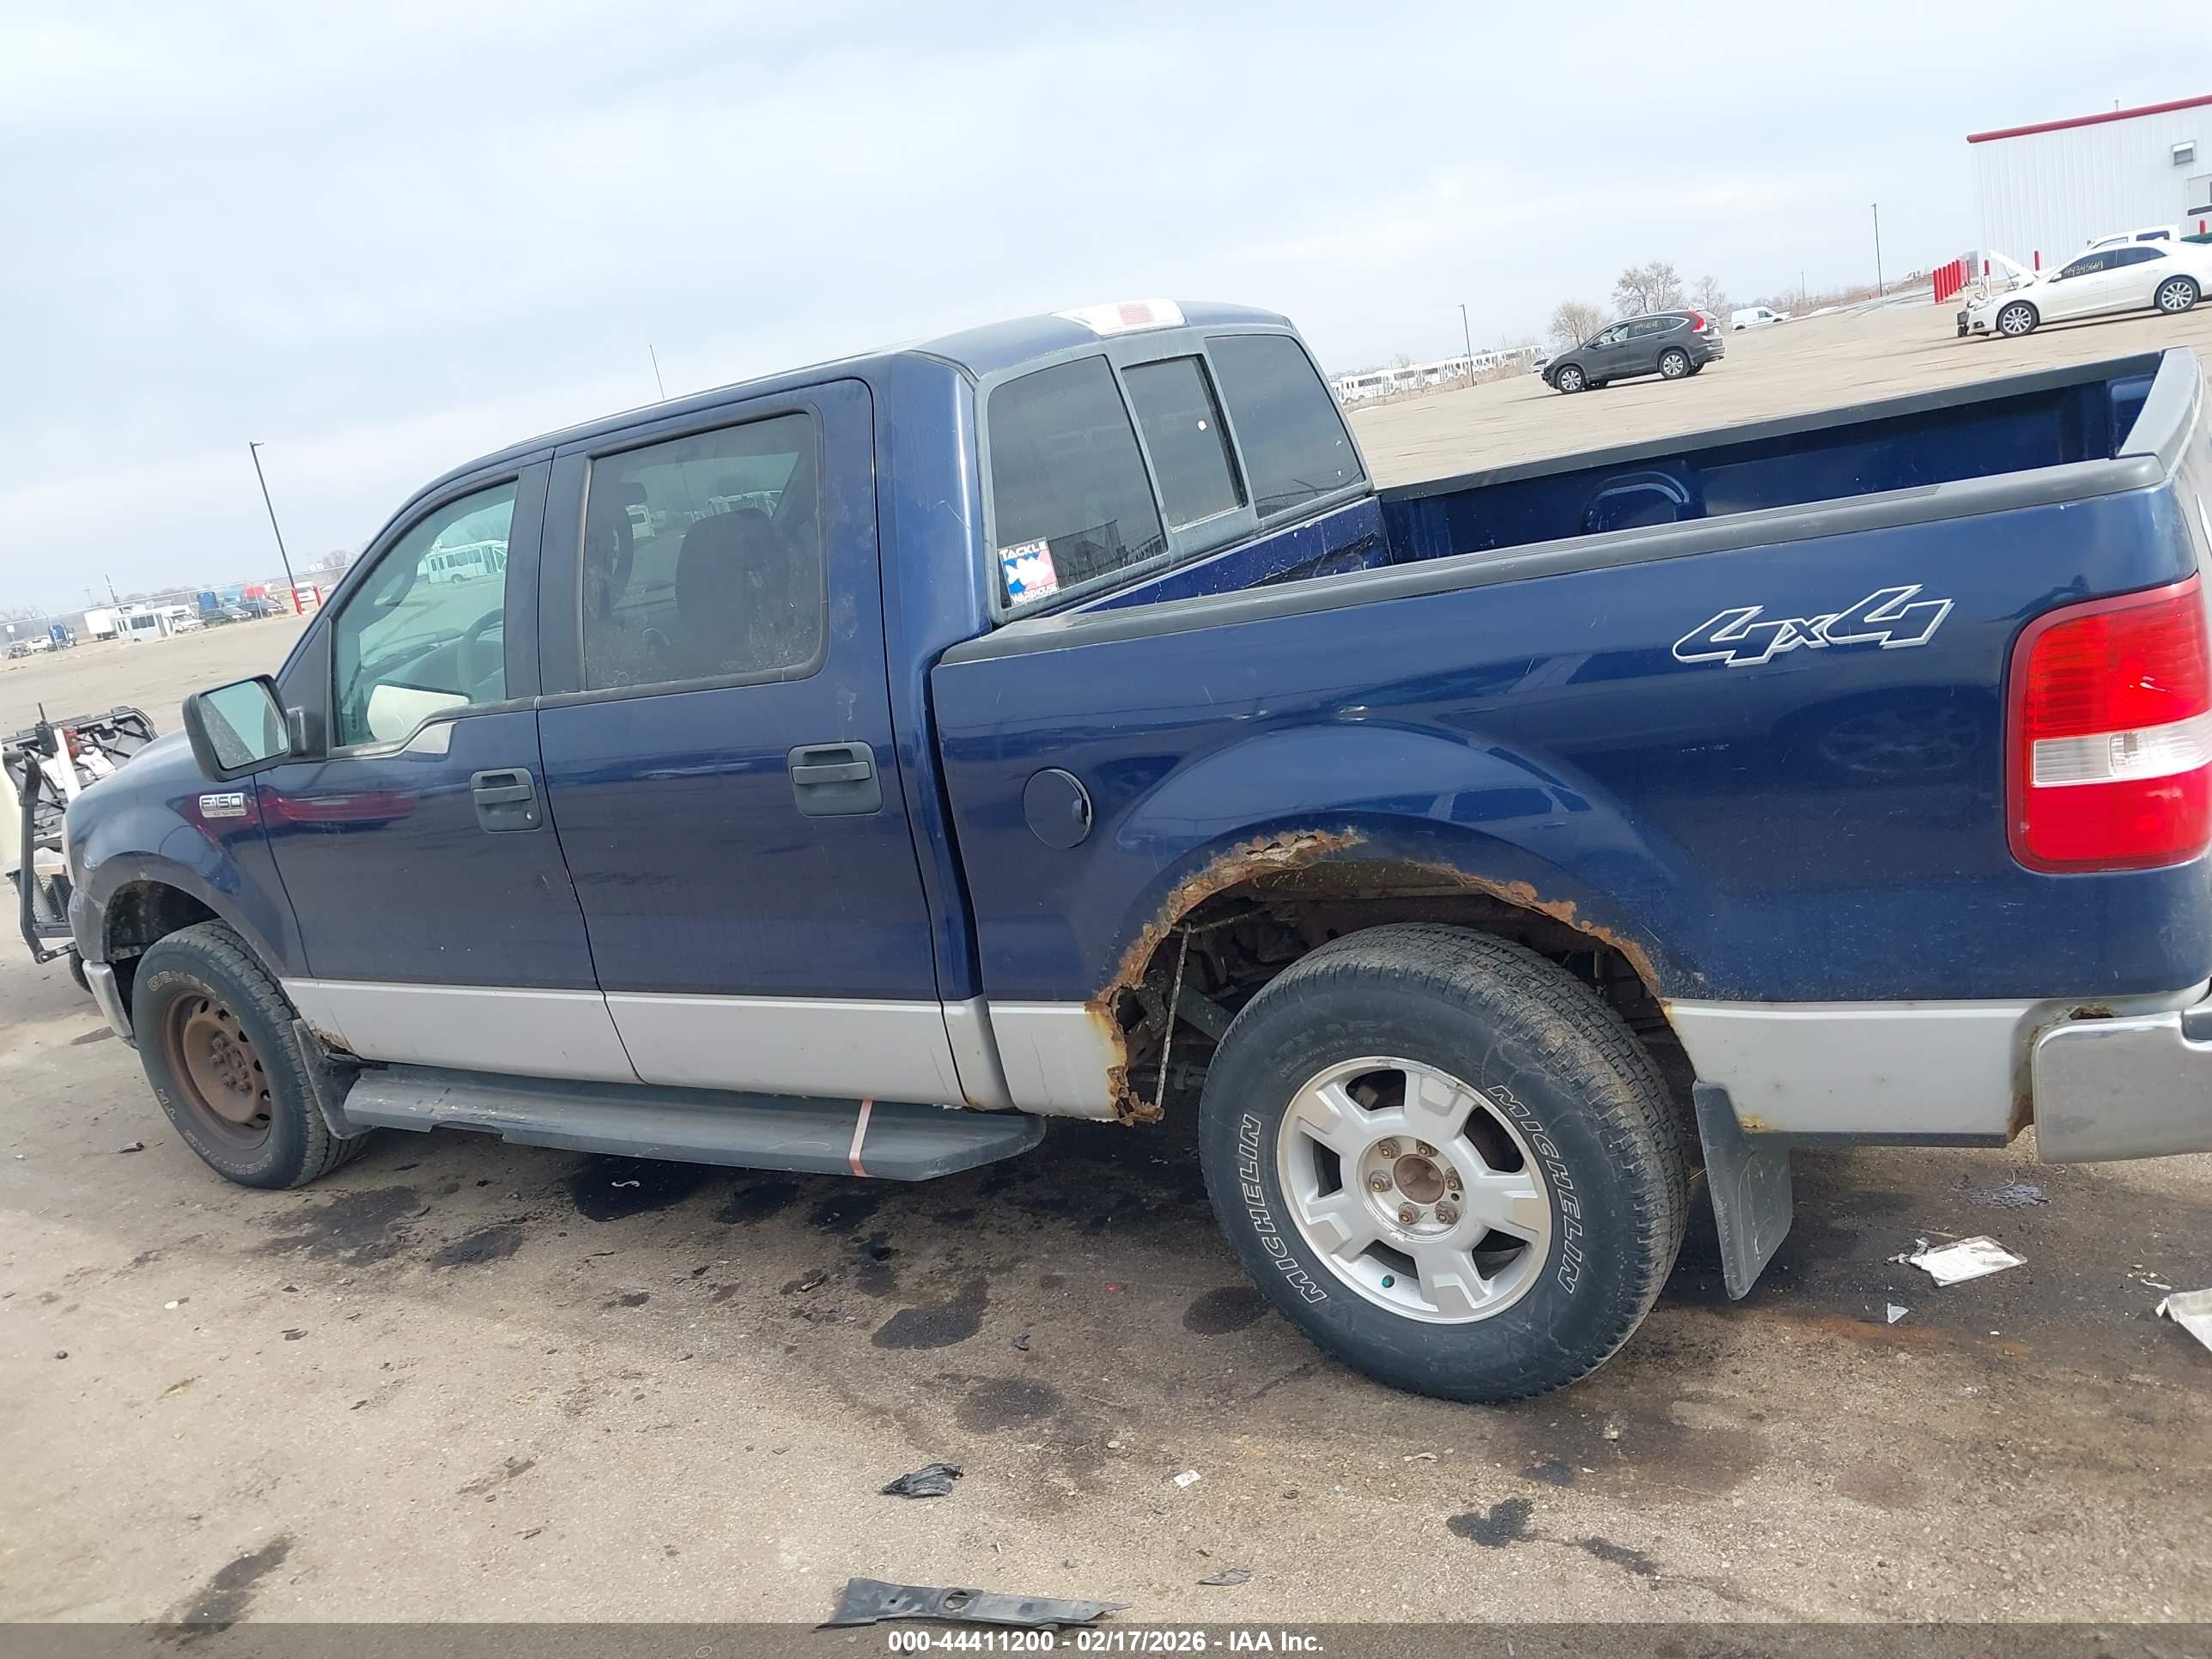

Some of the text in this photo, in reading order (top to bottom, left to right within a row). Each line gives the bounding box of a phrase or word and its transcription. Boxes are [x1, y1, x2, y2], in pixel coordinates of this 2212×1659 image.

[999, 540, 1048, 562] TACKLE
[1011, 582, 1058, 605] WAREHOUSE
[1672, 582, 1956, 668] 4x4
[1238, 1113, 1328, 1304] MICHELIN
[1487, 1085, 1583, 1294] MICHELIN
